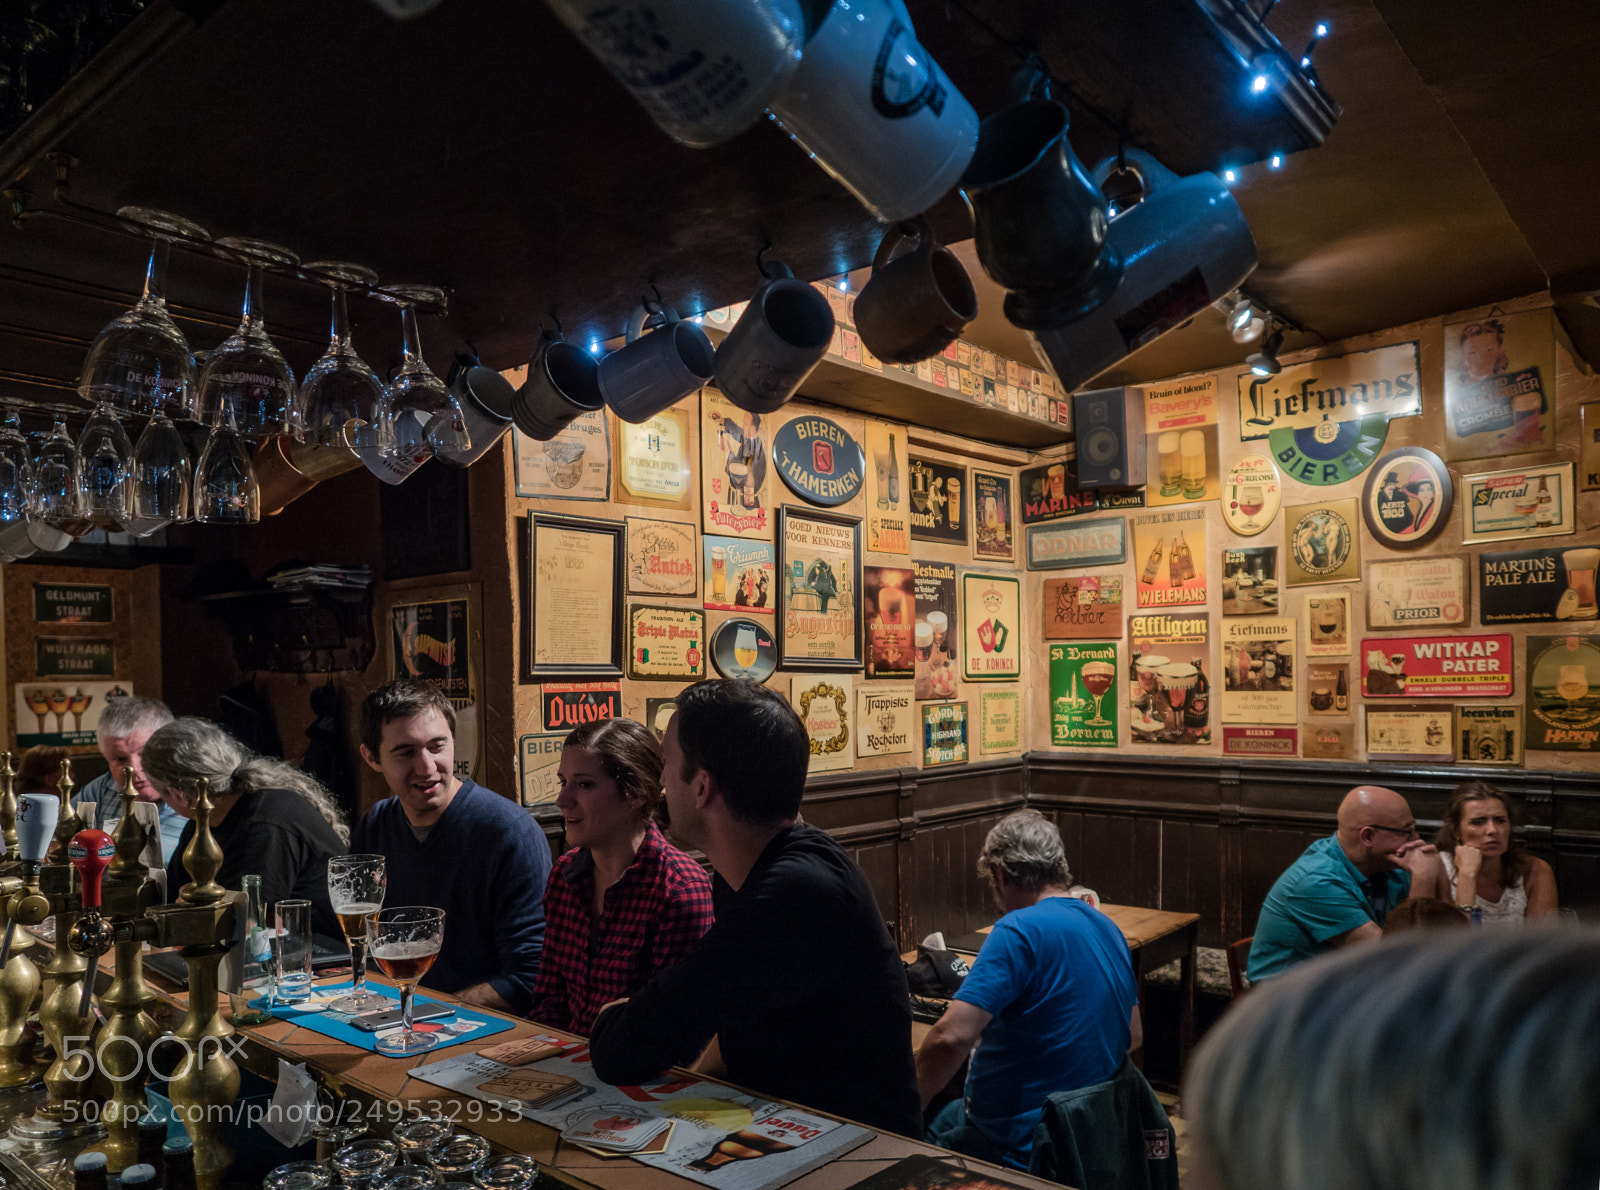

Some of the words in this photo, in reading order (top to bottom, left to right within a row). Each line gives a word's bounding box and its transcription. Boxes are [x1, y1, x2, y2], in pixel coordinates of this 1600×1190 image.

[1150, 388, 1173, 400] Bruin
[1174, 387, 1183, 396] of
[1184, 381, 1212, 394] blond?
[1150, 394, 1213, 415] Bavery's
[1246, 373, 1416, 426] Liefmans
[570, 421, 602, 436] Bruges
[796, 421, 846, 448] BIEREN
[1278, 434, 1381, 482] BIEREN
[788, 462, 860, 498] HAMERKEN
[1486, 477, 1525, 488] SUPER
[1025, 491, 1094, 518] MARINE
[1113, 493, 1142, 504] ORVAL
[1381, 500, 1406, 509] AERTS
[716, 512, 762, 530] Patersbier
[789, 520, 812, 533] GOED
[816, 523, 850, 538] NIEUWS
[880, 518, 904, 532] SPECIALE
[786, 531, 809, 543] VOOR
[726, 544, 770, 564] Triumph
[911, 562, 954, 580] Westmalle
[1485, 556, 1556, 574] MARTIN'S
[1486, 572, 1522, 586] PALE
[1526, 570, 1556, 584] ALE
[1138, 587, 1207, 606] WIELEMANS
[1416, 588, 1456, 600] Watou
[56, 606, 92, 616] STRAAT
[1396, 608, 1439, 619] PRIOR
[636, 621, 667, 640] Triple
[668, 624, 699, 640] Moine
[1132, 616, 1208, 638] Affligem
[1230, 624, 1288, 638] Liefmans
[1051, 648, 1064, 660] St
[1067, 647, 1116, 660] Bernard
[1412, 640, 1500, 660] WITKAP
[58, 660, 94, 669] STRAAT
[972, 657, 981, 670] DE
[986, 658, 1014, 670] KONINCK
[1442, 658, 1500, 673] PATER
[1410, 676, 1438, 684] ENKELE
[1441, 675, 1476, 684] DUBBELE
[1479, 674, 1506, 682] TRIPLE
[864, 694, 909, 716] Trappistes
[932, 728, 962, 740] HIGHLAND
[1054, 724, 1116, 740] Bornem
[1544, 729, 1599, 744] HAPKIN
[866, 732, 907, 750] Rochefort
[1230, 740, 1242, 750] DE
[1244, 740, 1291, 750] KONINCK
[928, 746, 954, 760] SCOTCH
[756, 1117, 822, 1140] Duvel
